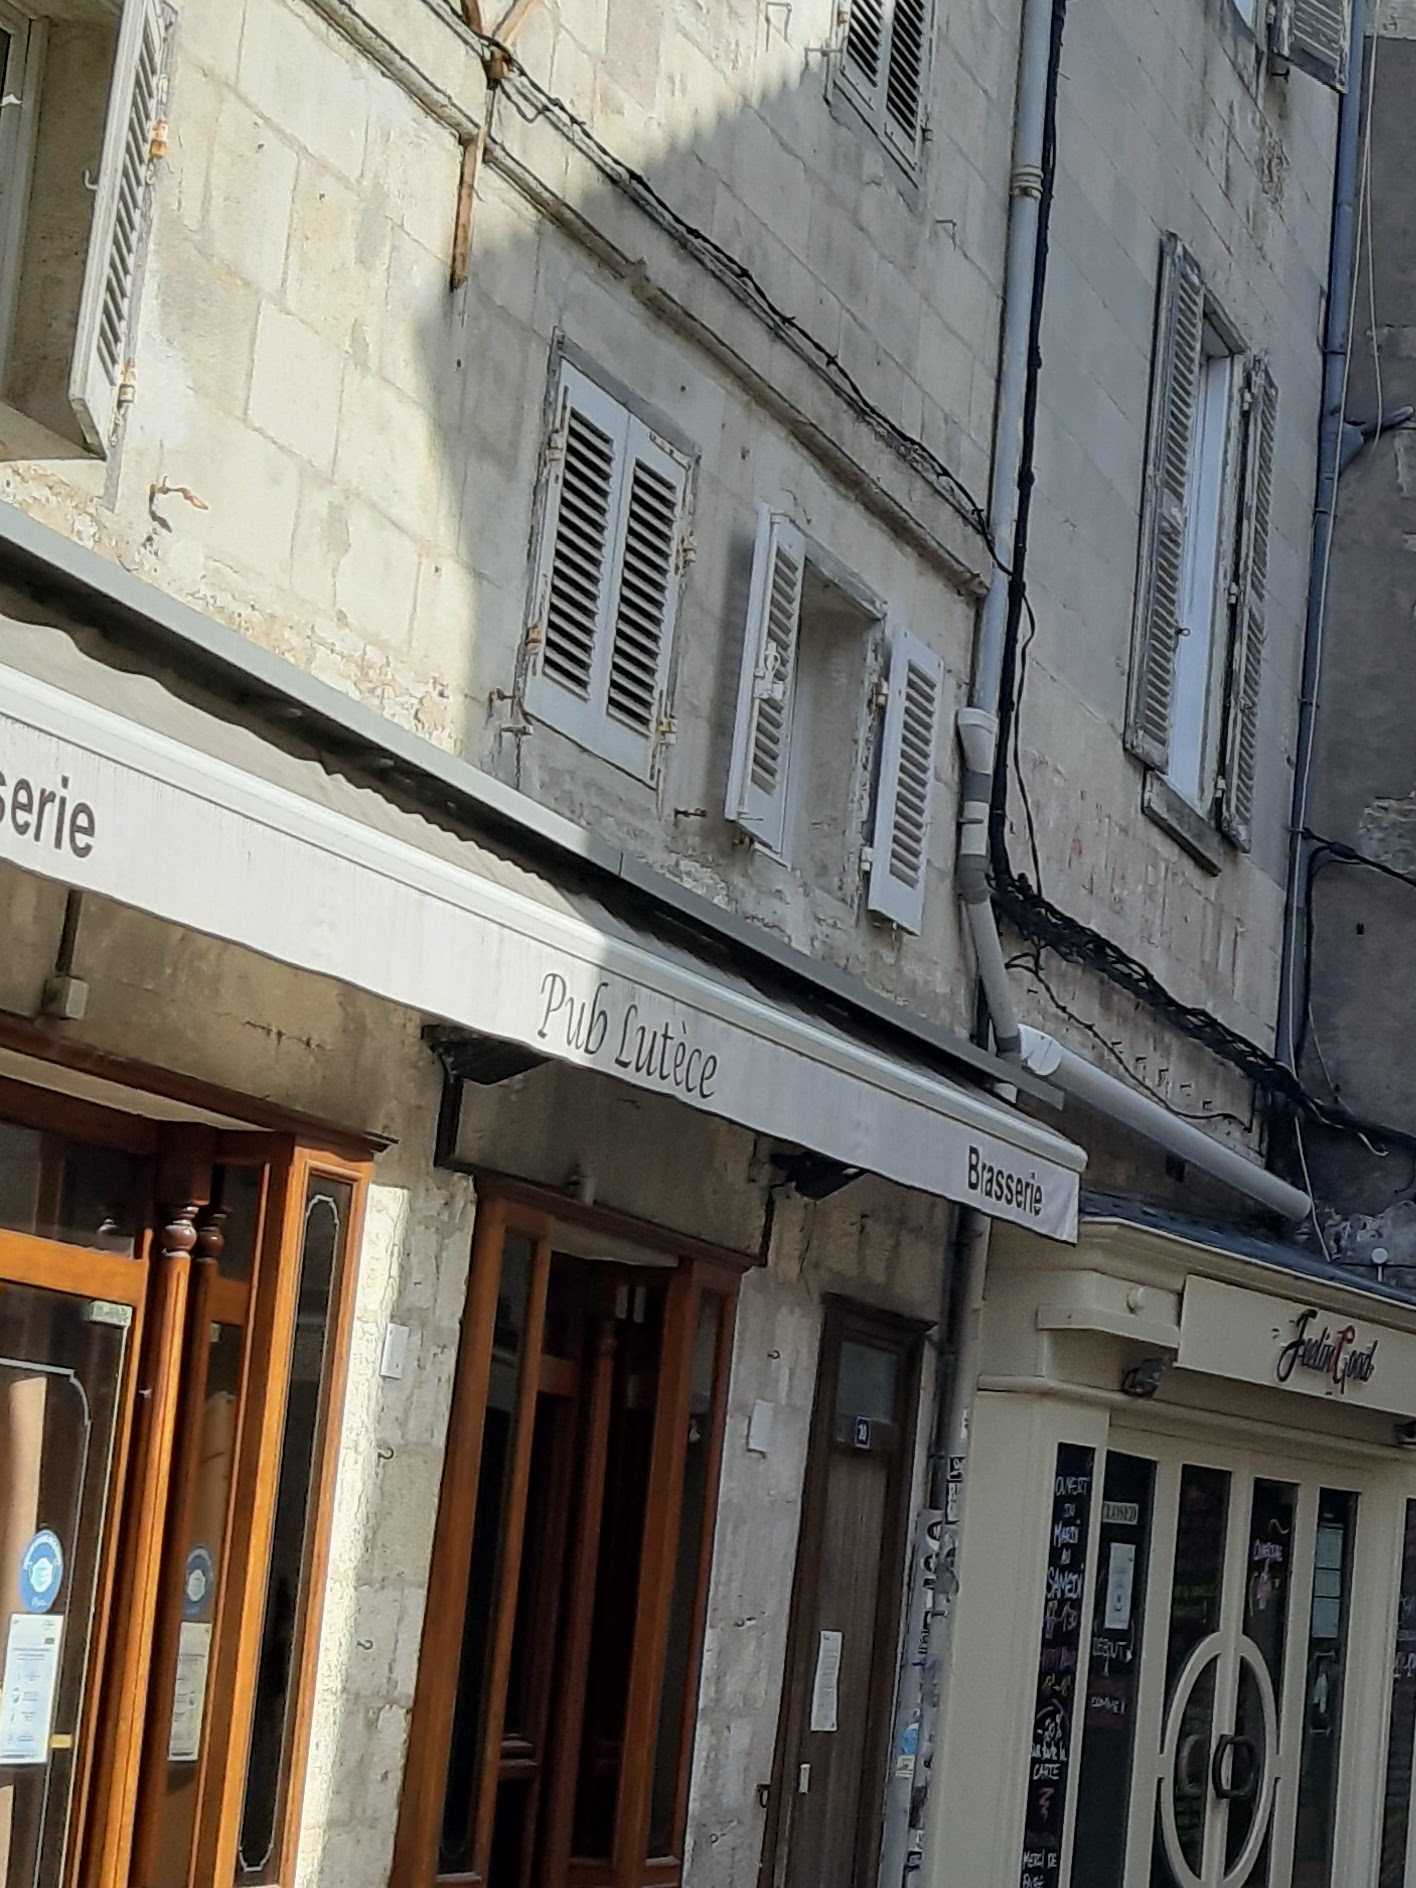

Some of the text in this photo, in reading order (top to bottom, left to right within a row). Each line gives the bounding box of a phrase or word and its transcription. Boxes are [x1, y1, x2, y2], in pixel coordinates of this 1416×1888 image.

[538, 973, 718, 1099] Pub Lutèce
[968, 1144, 1043, 1217] Brasserie
